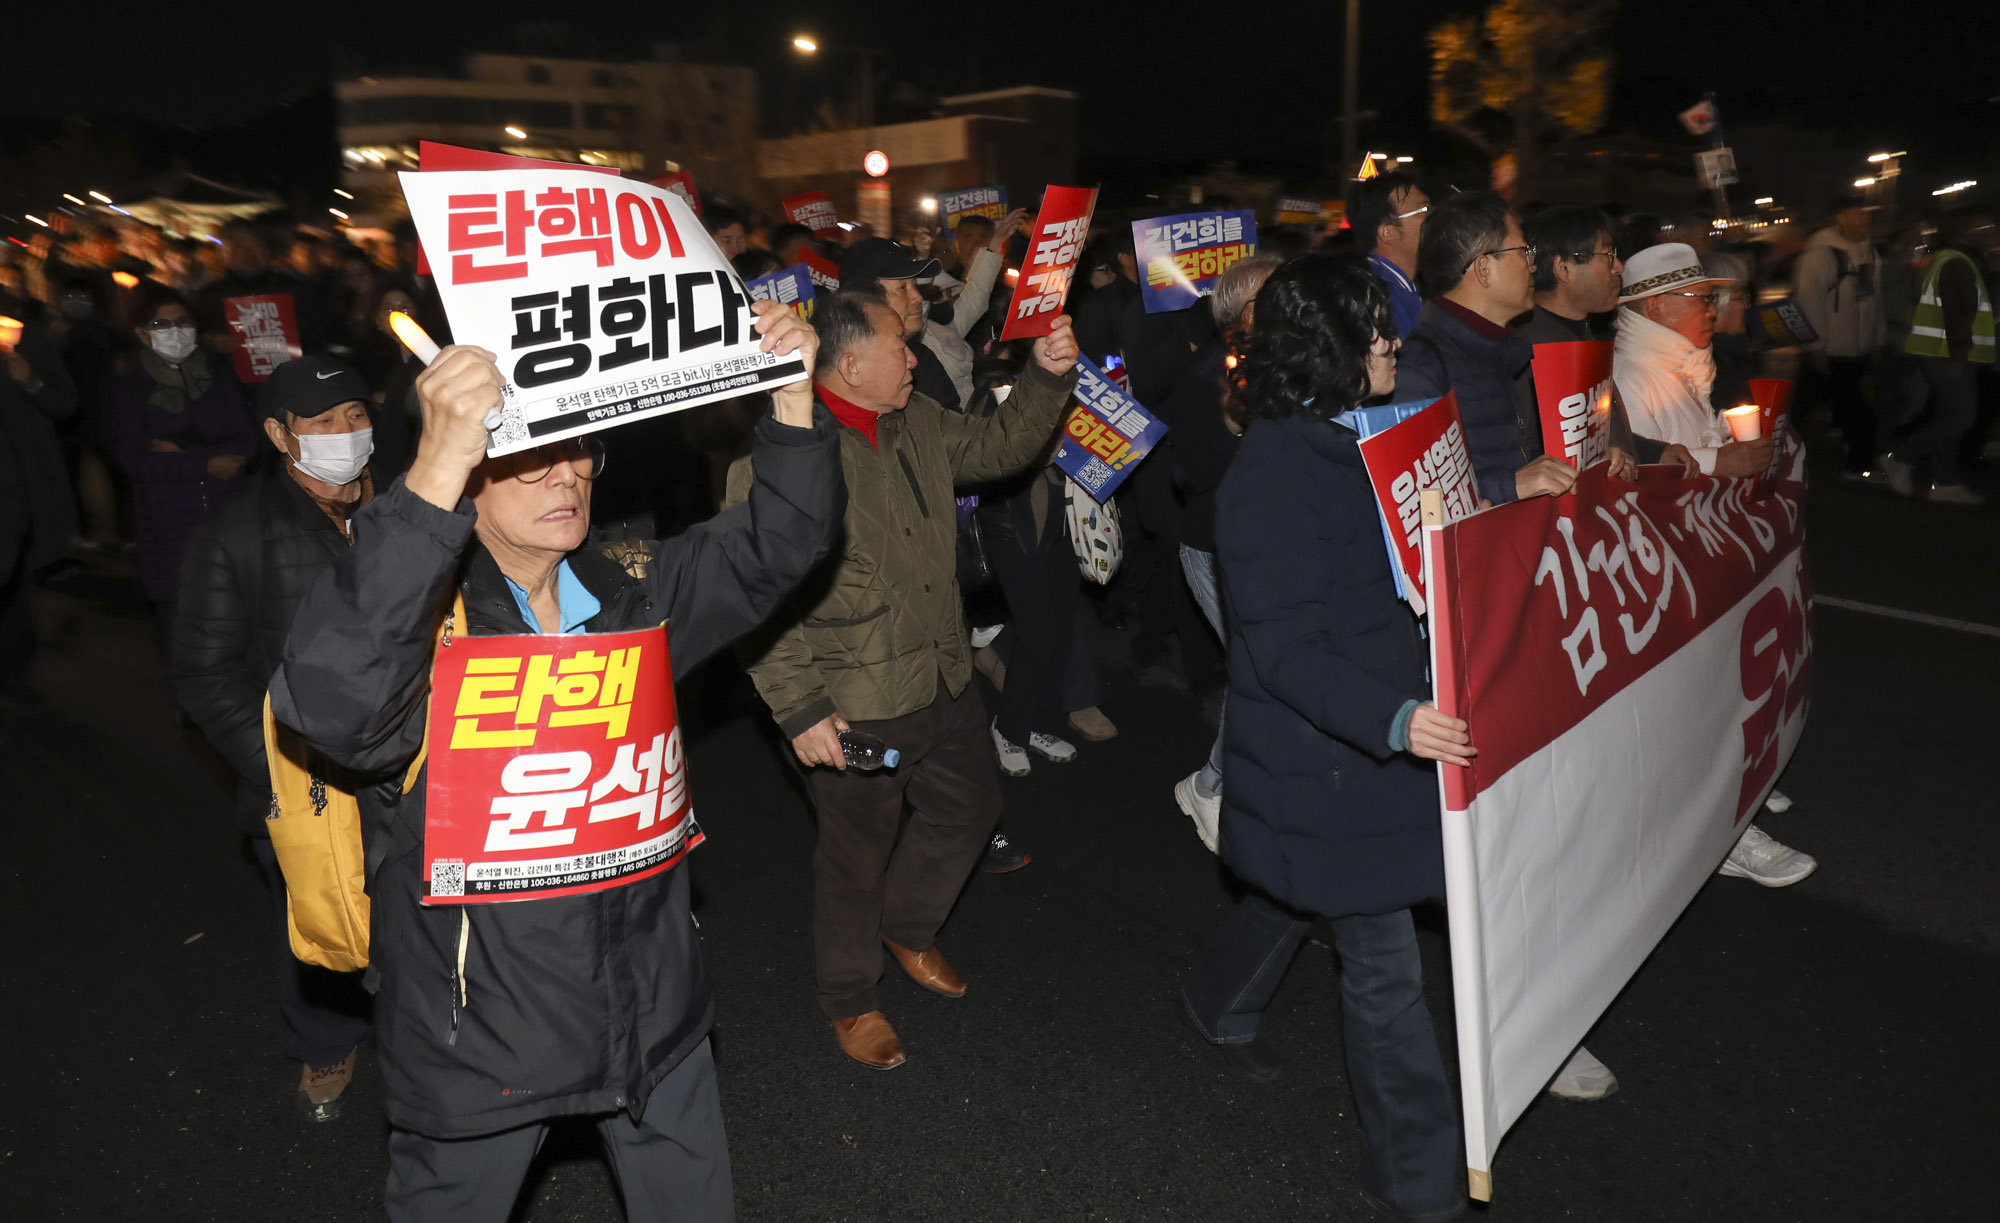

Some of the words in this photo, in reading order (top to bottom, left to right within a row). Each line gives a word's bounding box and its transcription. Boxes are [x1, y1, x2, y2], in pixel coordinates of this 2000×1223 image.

[448, 186, 686, 286] 탄핵이
[1145, 216, 1242, 253] 김건희를
[556, 391, 592, 412] 윤석열
[594, 381, 639, 402] 탄핵기금
[641, 377, 660, 391] 5억
[661, 374, 682, 386] 모금
[684, 352, 776, 382] bit.ly/윤석열탄핵기금
[587, 405, 617, 421] 탄핵기금
[618, 402, 632, 414] 모금
[637, 394, 663, 409] 신한은행
[1073, 361, 1151, 440] 건희를
[1066, 406, 1142, 471] 하라!
[449, 645, 642, 750] 탄핵
[483, 725, 688, 853] 윤석열
[475, 881, 491, 890] 후원
[498, 879, 528, 890] 신한은행
[530, 872, 590, 888] 100-036-164860
[622, 862, 635, 873] ARS
[476, 867, 502, 878] 윤석열
[527, 864, 551, 874] 김건희
[554, 862, 570, 872] 특검
[572, 849, 626, 870] 촛불대행진
